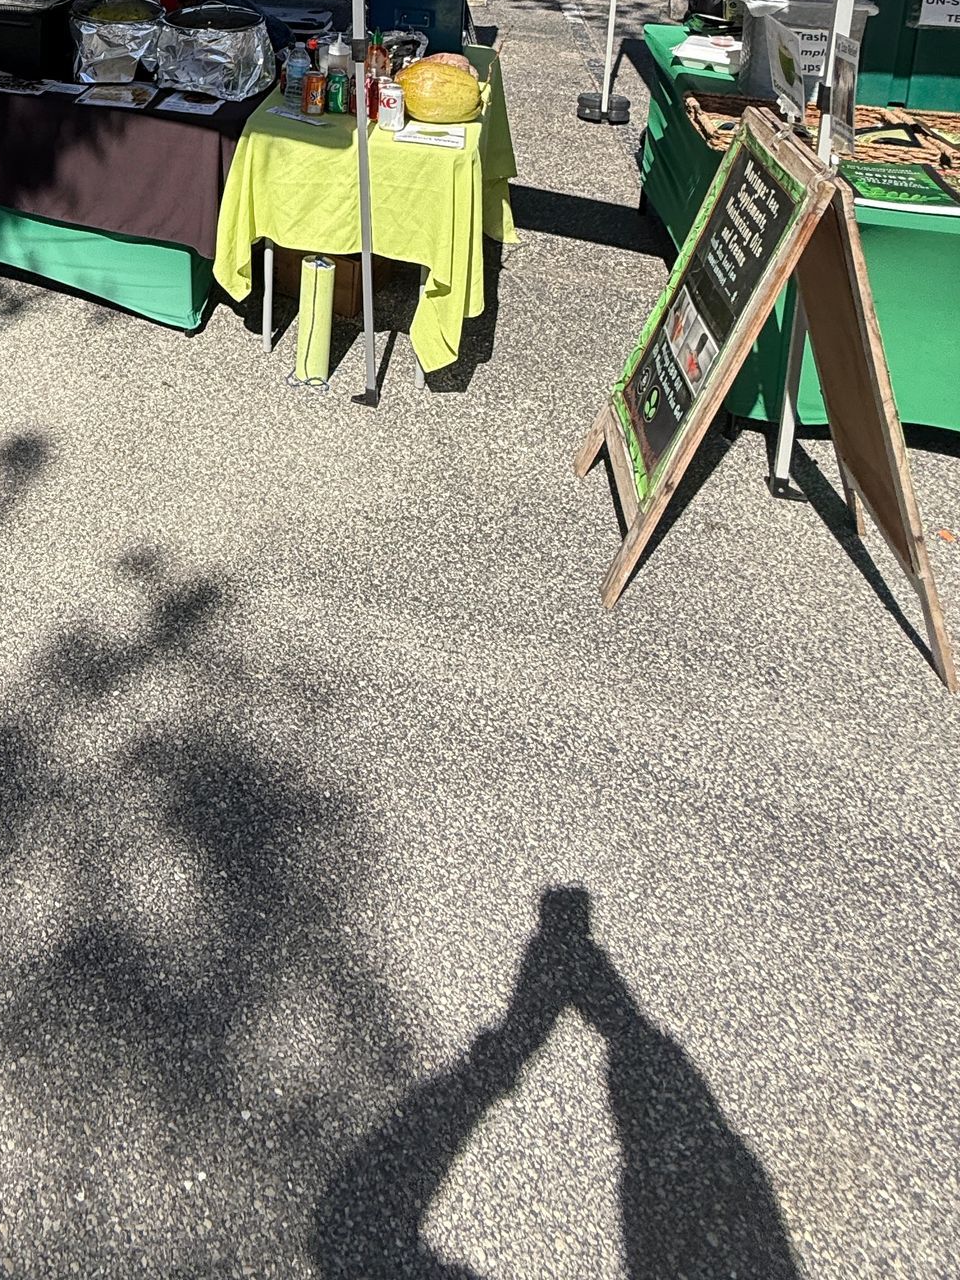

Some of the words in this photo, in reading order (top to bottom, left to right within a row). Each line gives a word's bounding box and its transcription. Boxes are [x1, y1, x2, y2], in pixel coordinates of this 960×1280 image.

[738, 183, 767, 233] Supplements,
[744, 160, 769, 200] Moringa:
[765, 189, 780, 219] Teas,
[721, 227, 734, 244] and
[729, 234, 746, 267] Creams
[726, 196, 752, 246] Moisturizing
[750, 232, 763, 258] Oils
[673, 405, 684, 422] Gel
